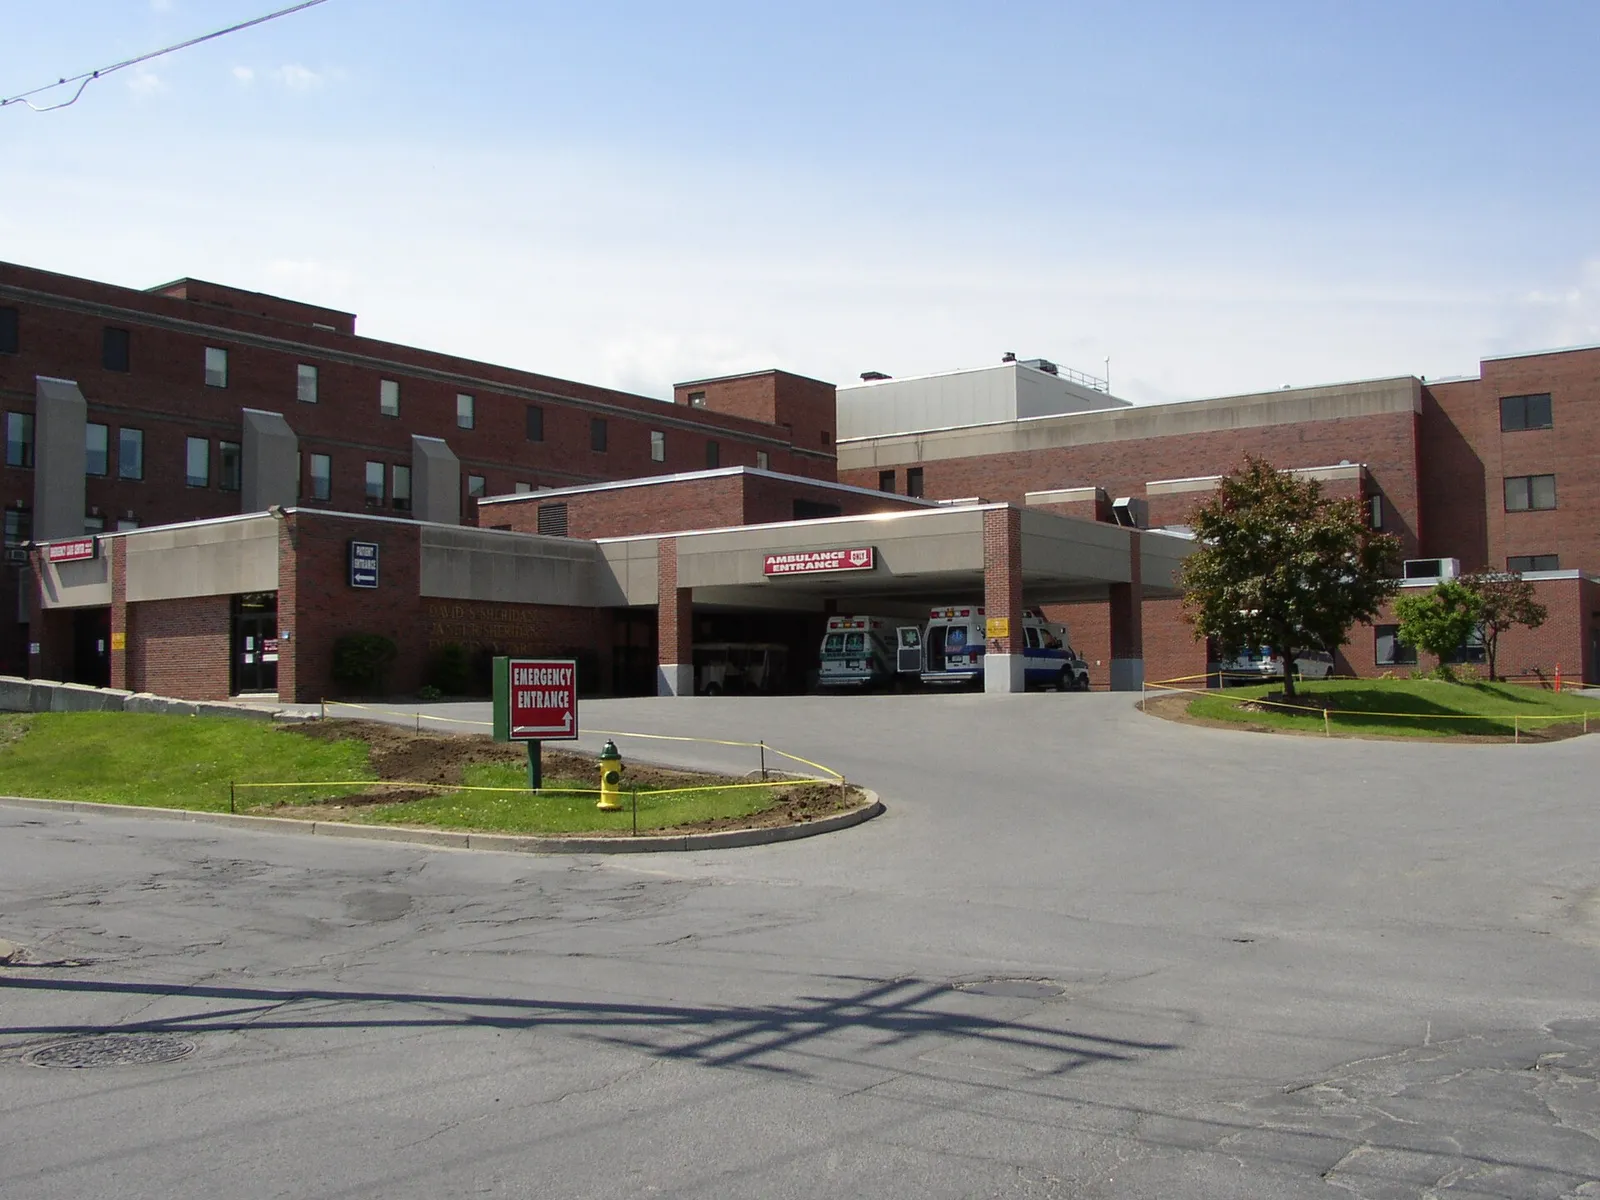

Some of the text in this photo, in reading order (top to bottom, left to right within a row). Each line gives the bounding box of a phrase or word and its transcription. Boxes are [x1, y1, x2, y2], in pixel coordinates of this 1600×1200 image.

[766, 551, 845, 564] AMBULANCE
[852, 552, 866, 561] ONLY
[354, 558, 377, 570] ENTRANCE
[772, 560, 839, 572] ENTRANCE
[514, 667, 572, 686] EMERGENCY
[518, 690, 569, 708] ENTRANCE
